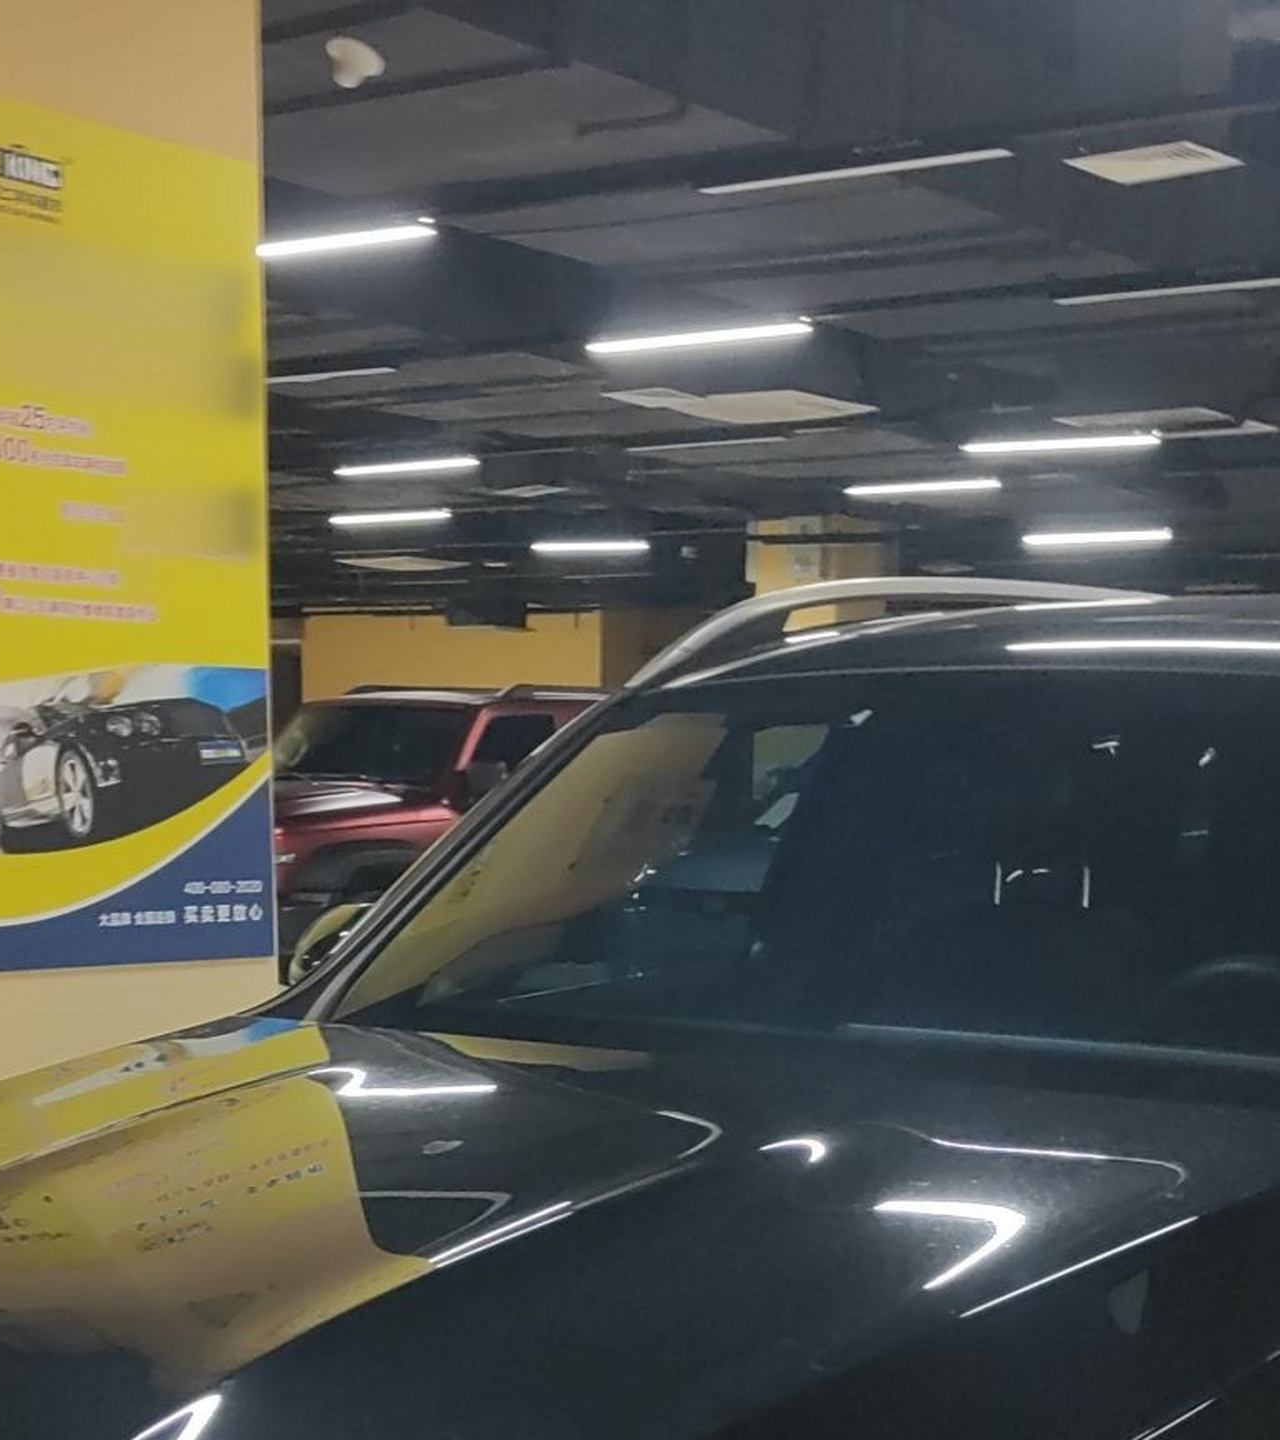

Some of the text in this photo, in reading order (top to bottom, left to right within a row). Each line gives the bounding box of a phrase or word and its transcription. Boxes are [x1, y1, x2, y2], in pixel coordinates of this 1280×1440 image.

[183, 903, 264, 925] 买卖更放心
